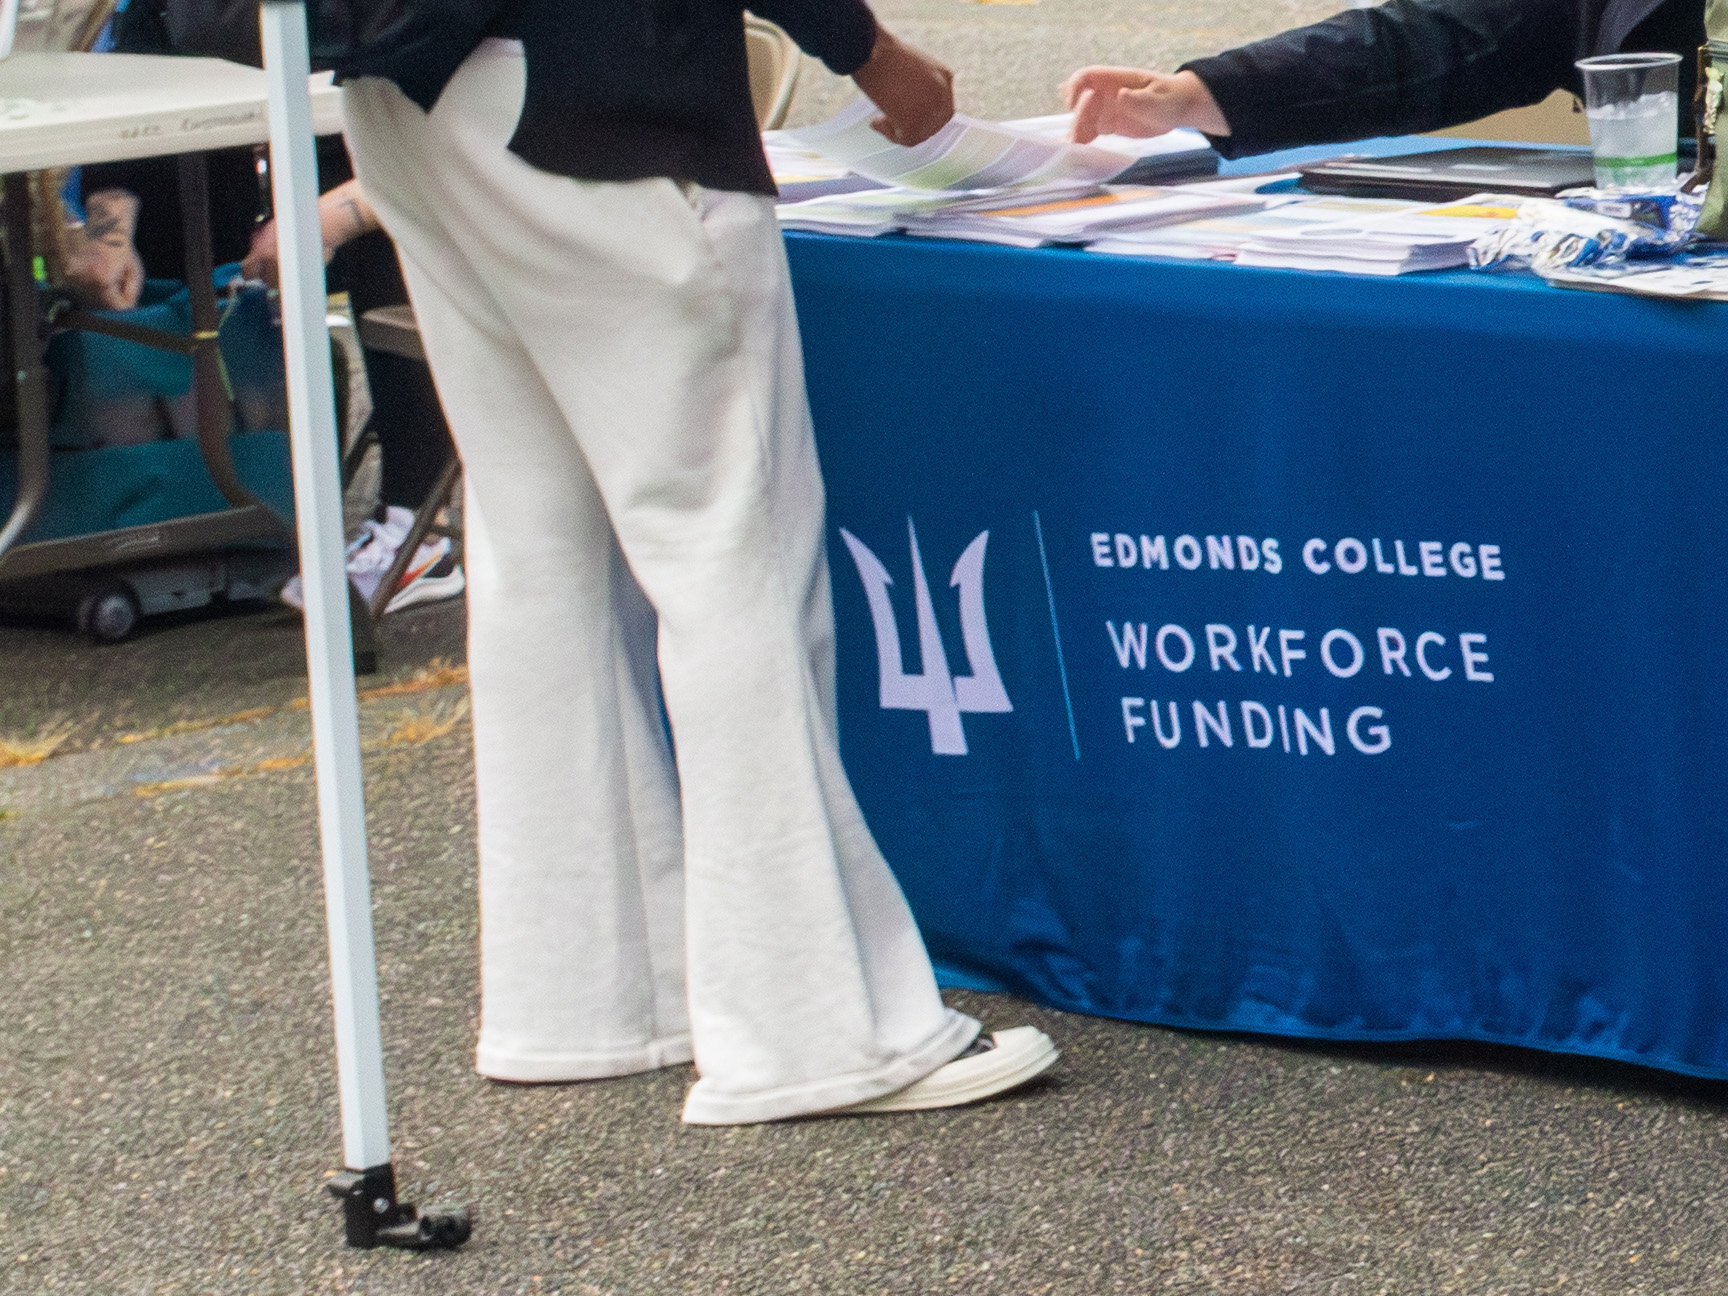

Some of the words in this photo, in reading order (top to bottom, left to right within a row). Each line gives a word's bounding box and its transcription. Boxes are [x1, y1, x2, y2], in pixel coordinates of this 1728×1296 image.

[1090, 531, 1283, 575] EDMONDS
[1302, 536, 1506, 581] COLLEGE
[1105, 619, 1495, 683] WORKFORCE
[1120, 697, 1393, 756] FUNDING
